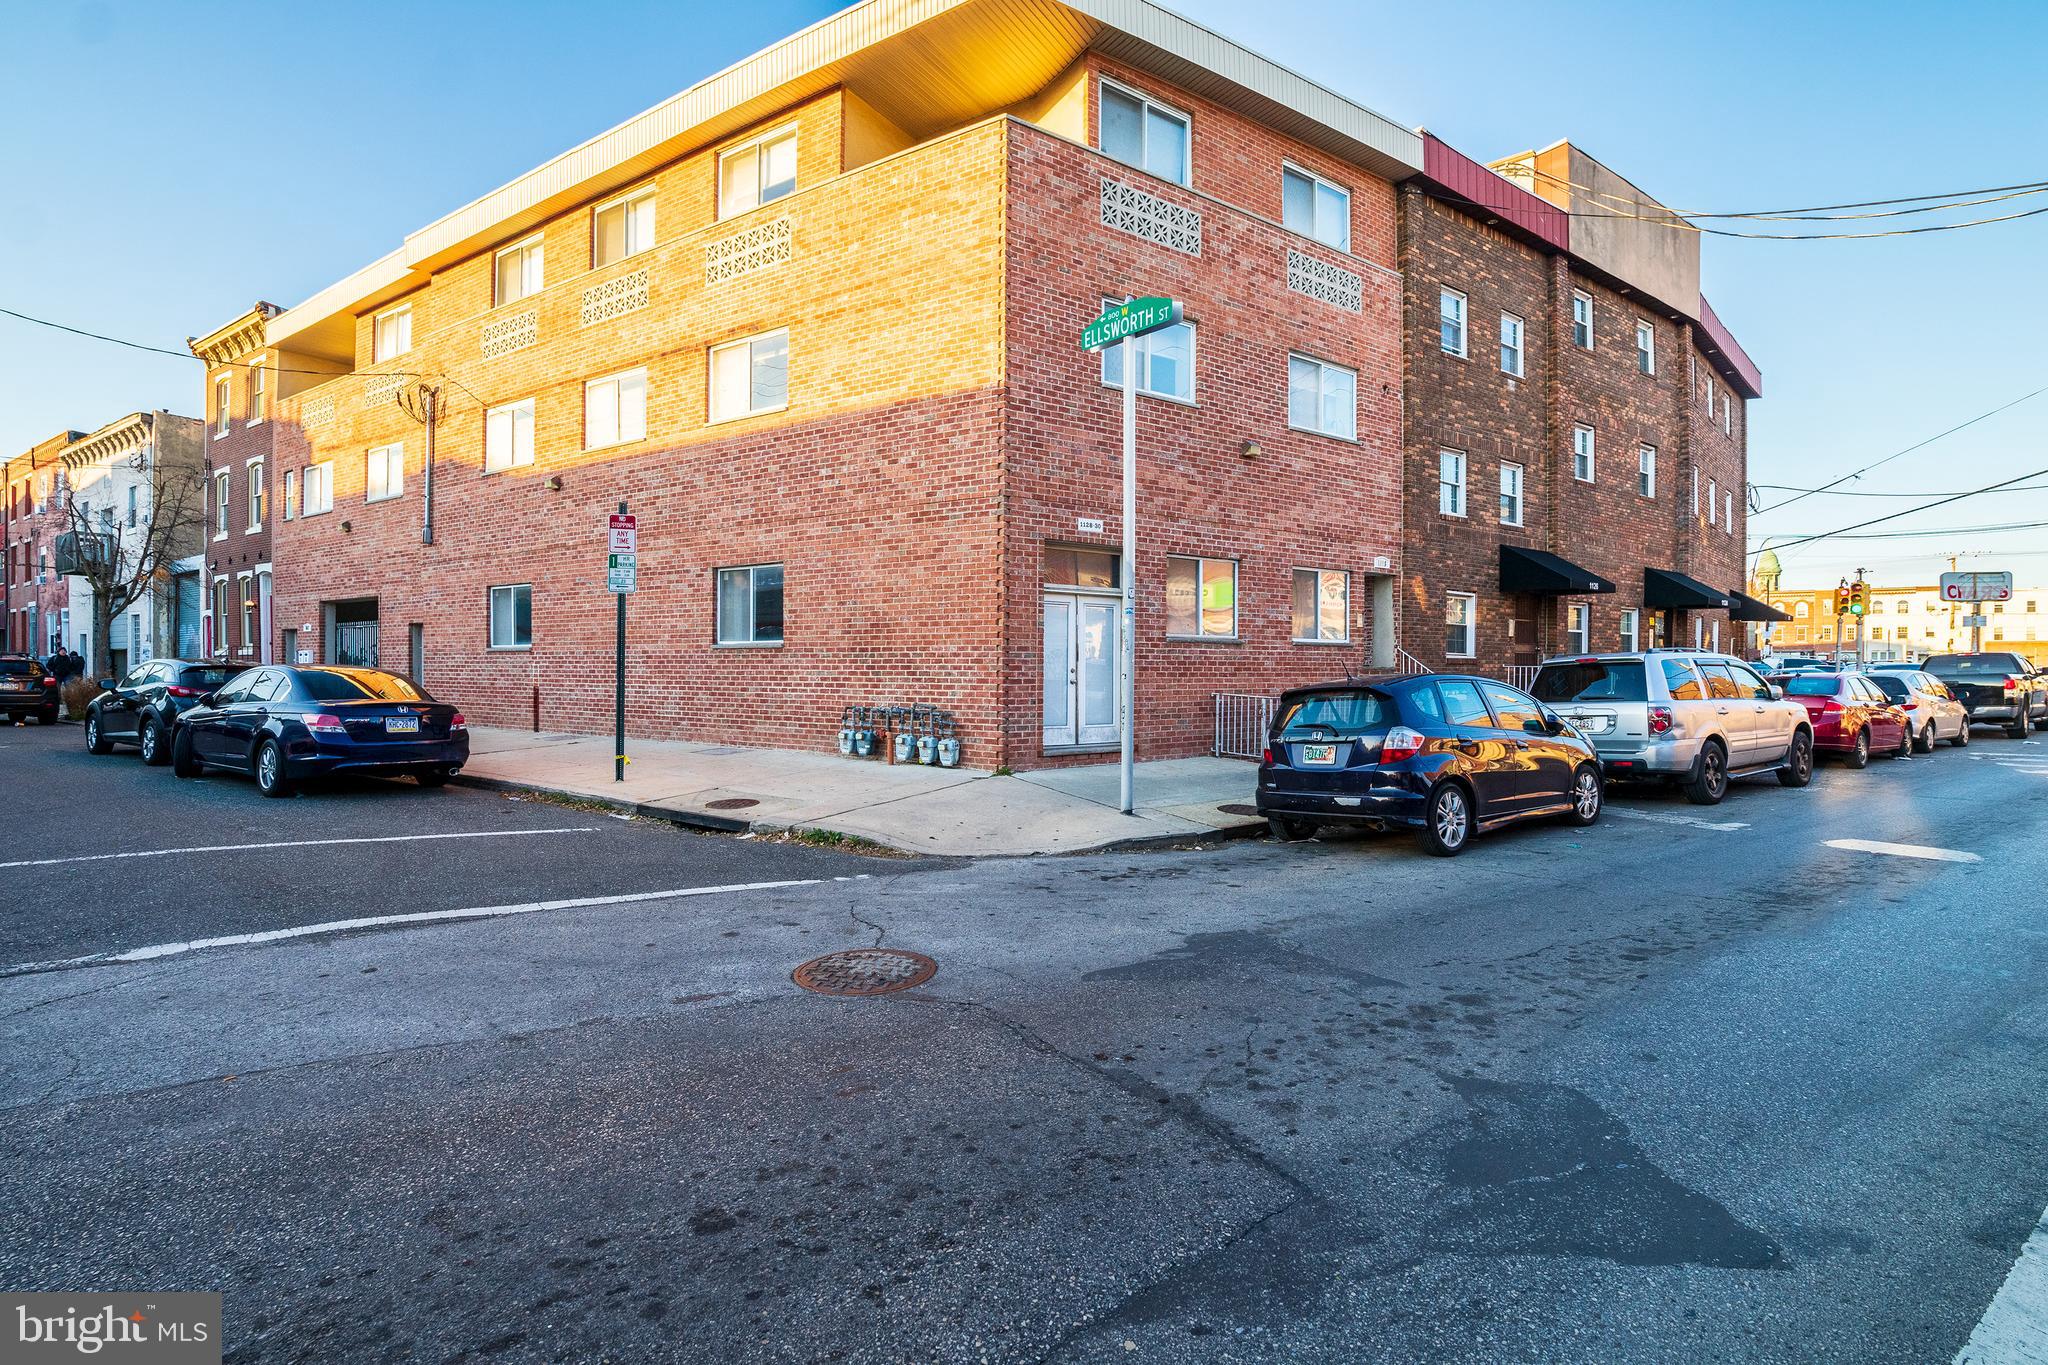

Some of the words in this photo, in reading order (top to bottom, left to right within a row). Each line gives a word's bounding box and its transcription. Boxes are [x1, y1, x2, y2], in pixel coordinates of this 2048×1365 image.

[1084, 307, 1153, 348] ELLSWORTH
[1158, 306, 1169, 321] ST
[1108, 311, 1119, 320] 800
[1121, 306, 1129, 316] W
